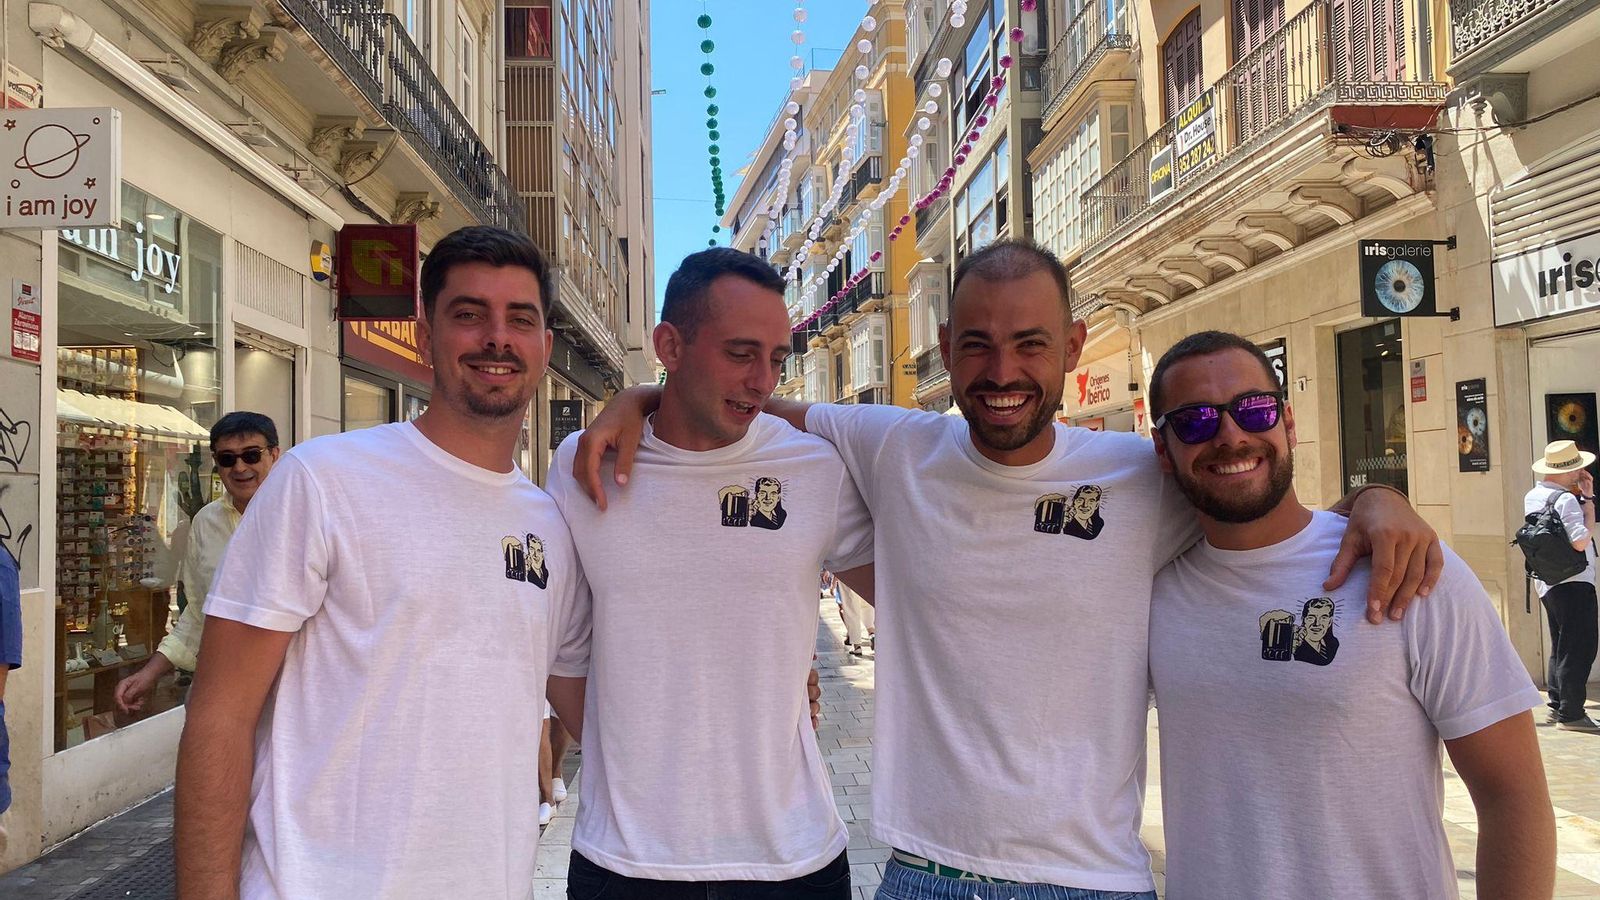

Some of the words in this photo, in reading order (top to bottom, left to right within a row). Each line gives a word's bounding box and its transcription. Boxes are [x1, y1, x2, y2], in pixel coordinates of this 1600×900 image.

[1179, 93, 1211, 129] ALQUILA
[1184, 129, 1193, 144] Dr.
[1192, 116, 1211, 138] House
[1151, 162, 1171, 185] OFICINA
[7, 195, 11, 216] i
[19, 199, 55, 216] am
[61, 194, 97, 220] joy
[131, 221, 181, 294] joy
[1364, 243, 1432, 260] irisgalerie
[1538, 252, 1600, 299] iris
[1350, 474, 1367, 488] SALE
